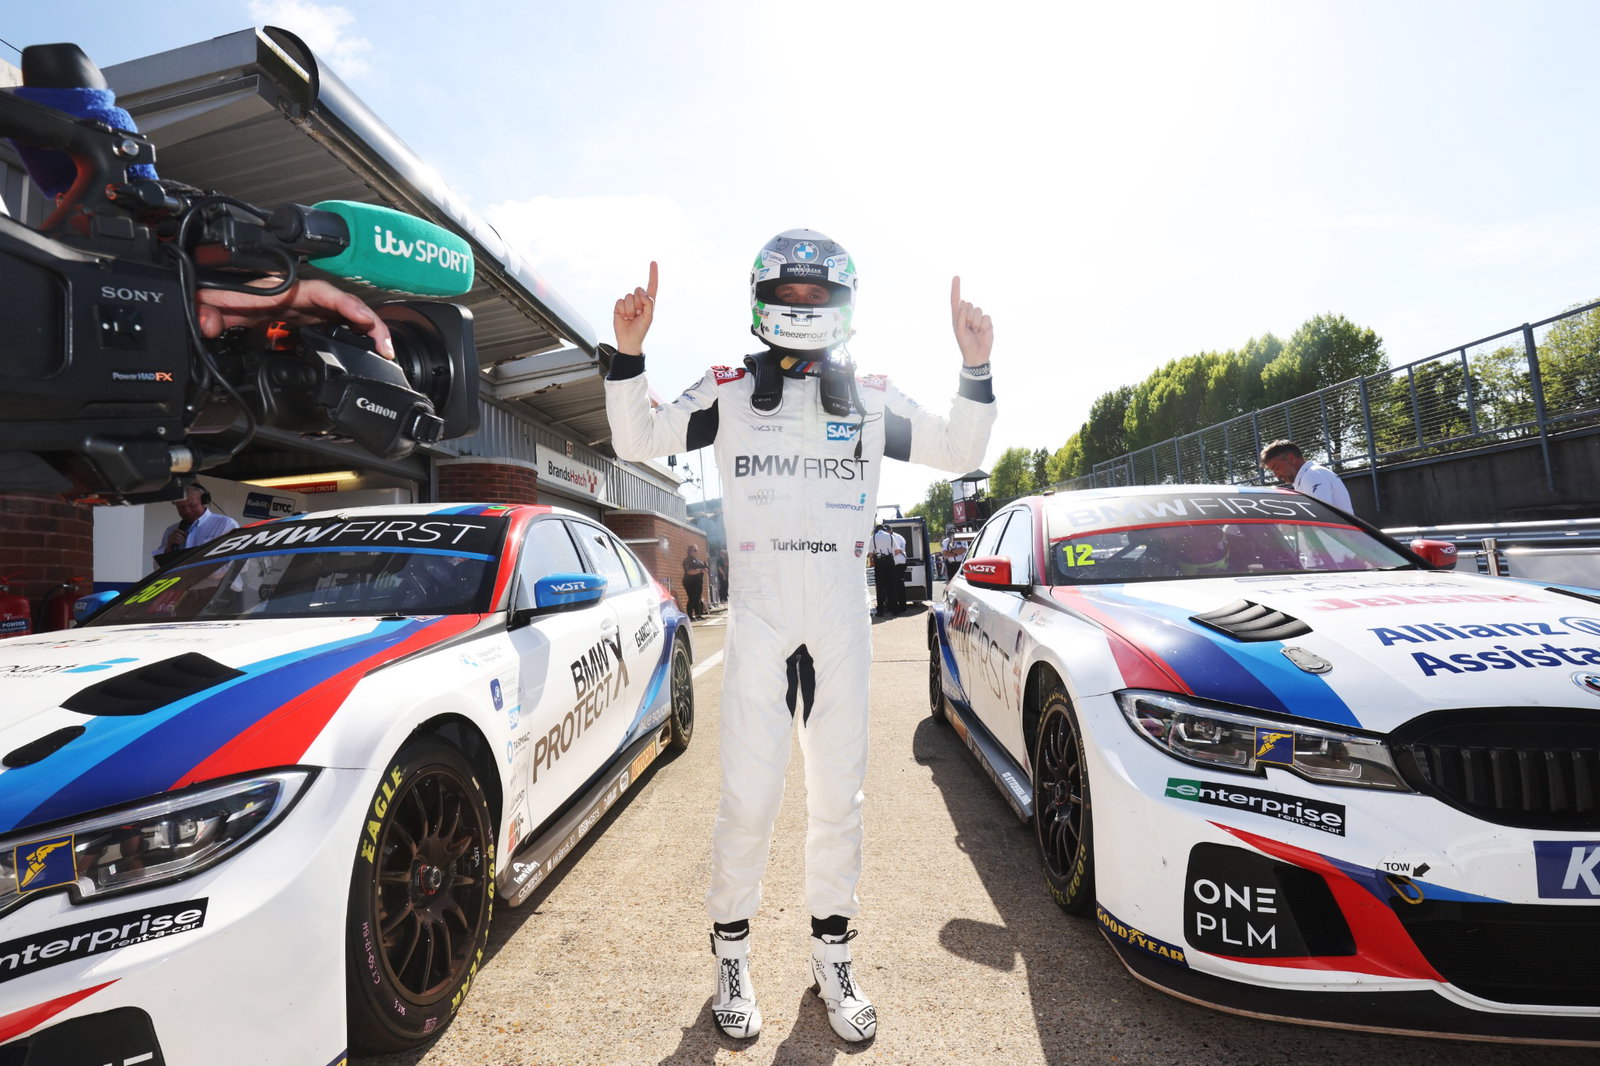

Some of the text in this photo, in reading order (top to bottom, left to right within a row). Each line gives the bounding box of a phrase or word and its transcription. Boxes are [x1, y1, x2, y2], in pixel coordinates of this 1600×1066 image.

[374, 226, 470, 274] itv SPORT
[101, 286, 163, 303] SONY
[716, 369, 739, 379] OMP
[356, 397, 398, 421] Canon
[827, 424, 858, 438] SAP
[735, 455, 869, 481] BMW FIRST
[272, 502, 292, 513] BTCC
[1066, 497, 1318, 528] BMW FIRST
[204, 520, 486, 557] BMW FIRST
[770, 539, 837, 553] Turkington
[1062, 543, 1095, 567] 12
[969, 564, 996, 573] WSR
[550, 579, 587, 593] WSR
[1367, 616, 1570, 646] Allianz
[570, 637, 611, 701] BMW
[533, 671, 613, 784] PROTECT
[361, 765, 403, 864] EAGLE
[1166, 785, 1342, 827] enterprise
[1277, 813, 1342, 834] rent-a-car
[1384, 862, 1411, 872] TOW
[1193, 879, 1277, 913] ONE
[110, 921, 200, 949] rent-a-car
[1196, 911, 1277, 950] PLM
[718, 1013, 746, 1025] OMP
[855, 1005, 876, 1026] OMP
